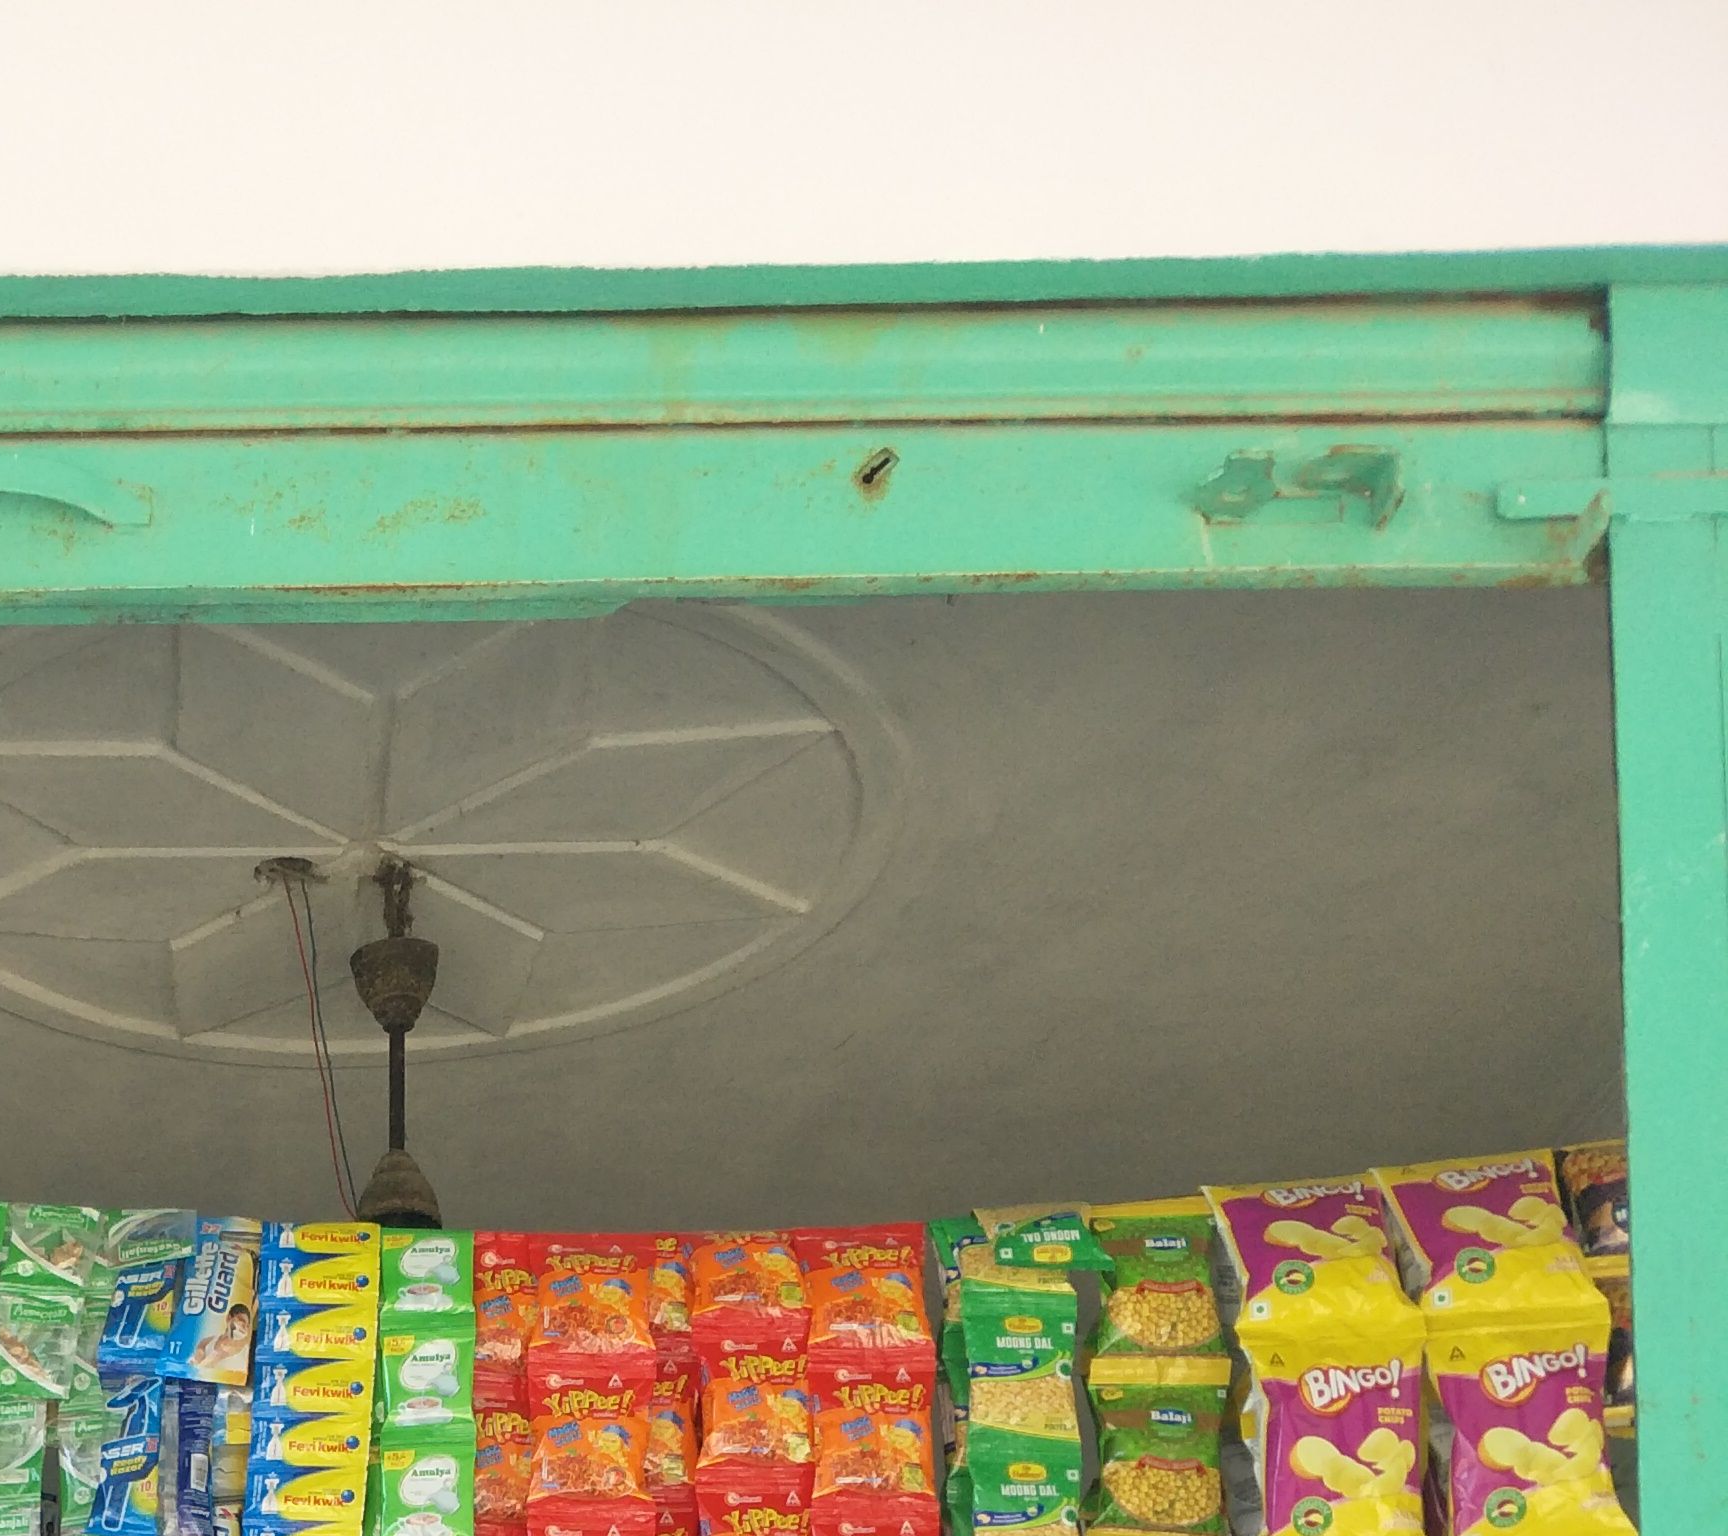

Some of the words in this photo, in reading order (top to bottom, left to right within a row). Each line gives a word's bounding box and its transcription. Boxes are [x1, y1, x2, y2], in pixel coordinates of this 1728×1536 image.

[410, 1245, 451, 1255] Amulya
[1145, 1237, 1188, 1250] Balaji
[183, 1241, 219, 1316] Gillette
[208, 1250, 240, 1314] Guard
[410, 1352, 452, 1364] Amulya
[1487, 1345, 1589, 1400] BINGO!
[1306, 1359, 1401, 1409] BINGO!
[1150, 1410, 1194, 1424] Balaji
[410, 1467, 451, 1479] Amulya
